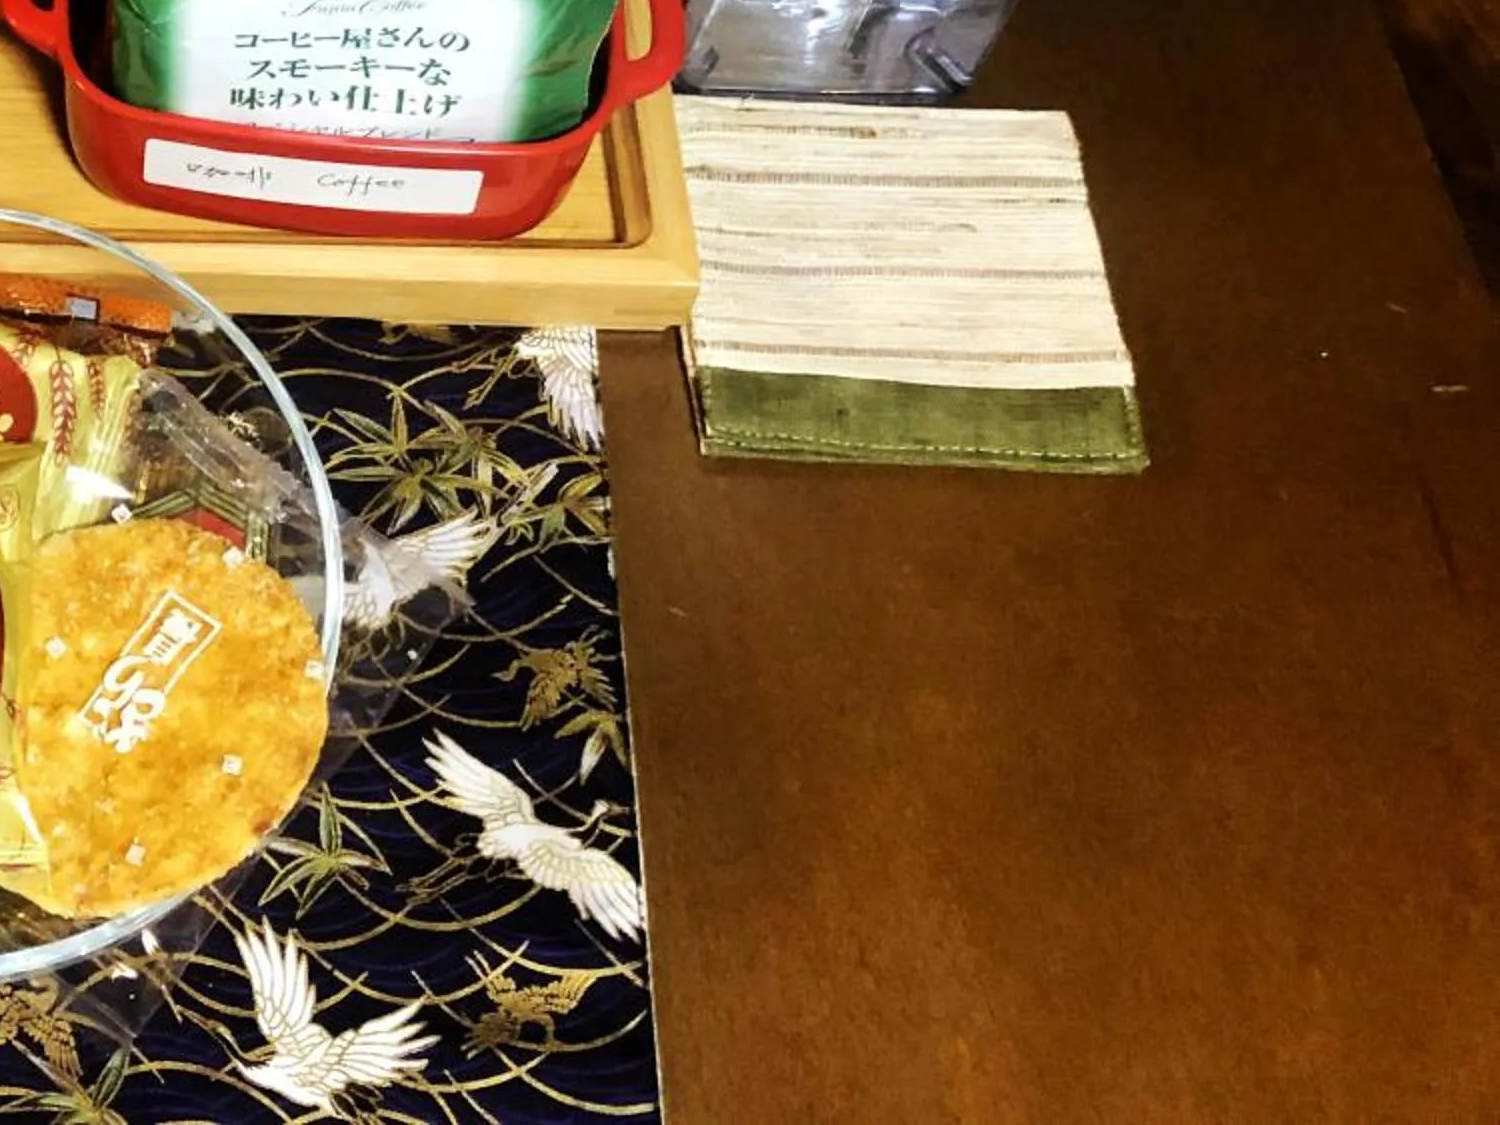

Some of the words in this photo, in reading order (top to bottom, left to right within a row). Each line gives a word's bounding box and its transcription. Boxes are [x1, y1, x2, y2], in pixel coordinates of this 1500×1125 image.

[233, 26, 471, 52] コーヒー屋さんの
[246, 55, 452, 86] スモーキーな
[229, 85, 463, 118] 味わい仕上げ
[316, 170, 406, 196] Coffee
